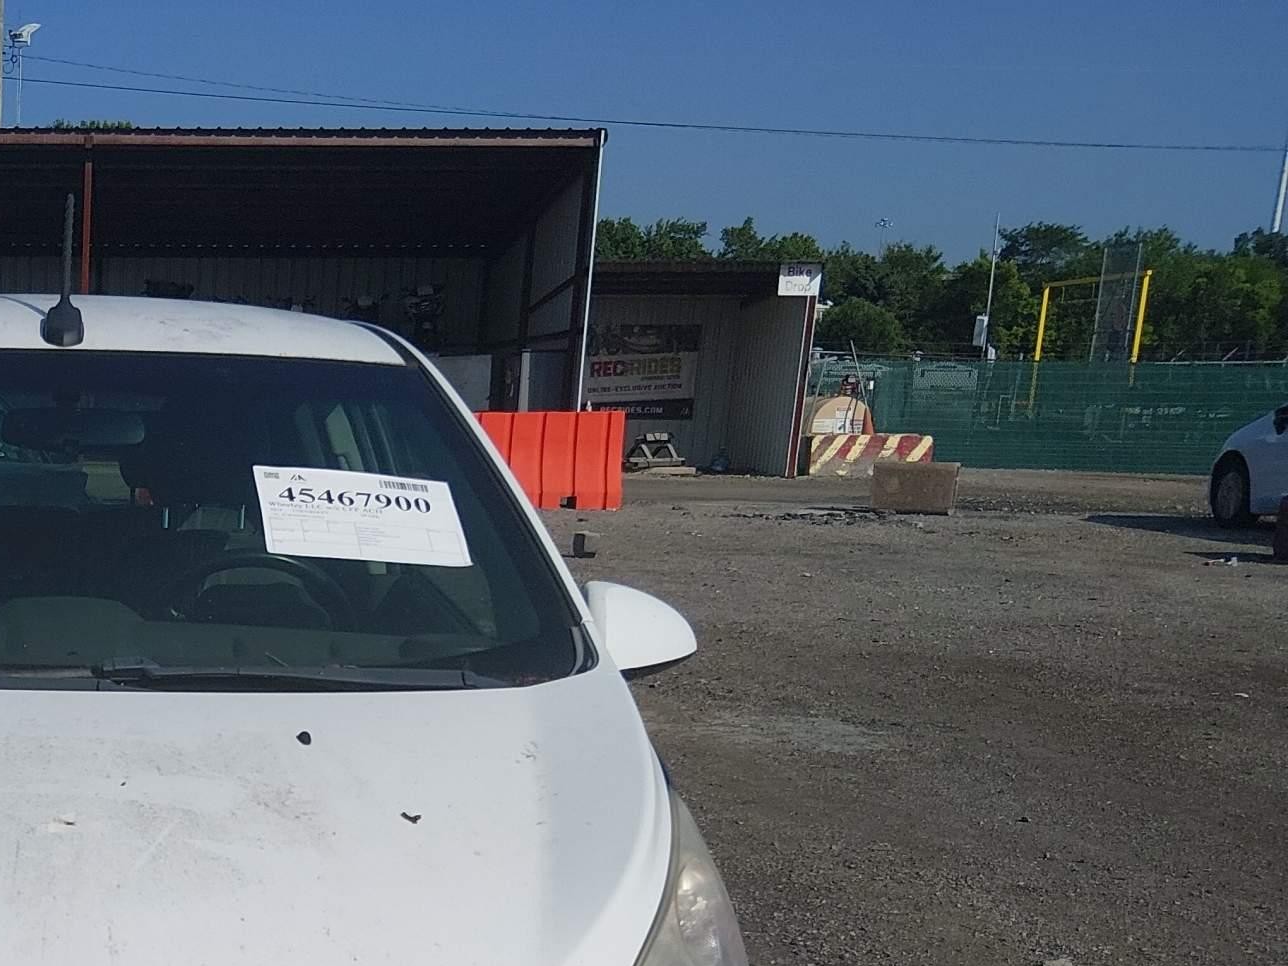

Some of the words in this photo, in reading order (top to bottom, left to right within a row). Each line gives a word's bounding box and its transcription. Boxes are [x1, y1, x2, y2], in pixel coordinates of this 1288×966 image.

[787, 264, 812, 278] Bike
[785, 280, 811, 294] Drop
[279, 487, 431, 513] 45467900
